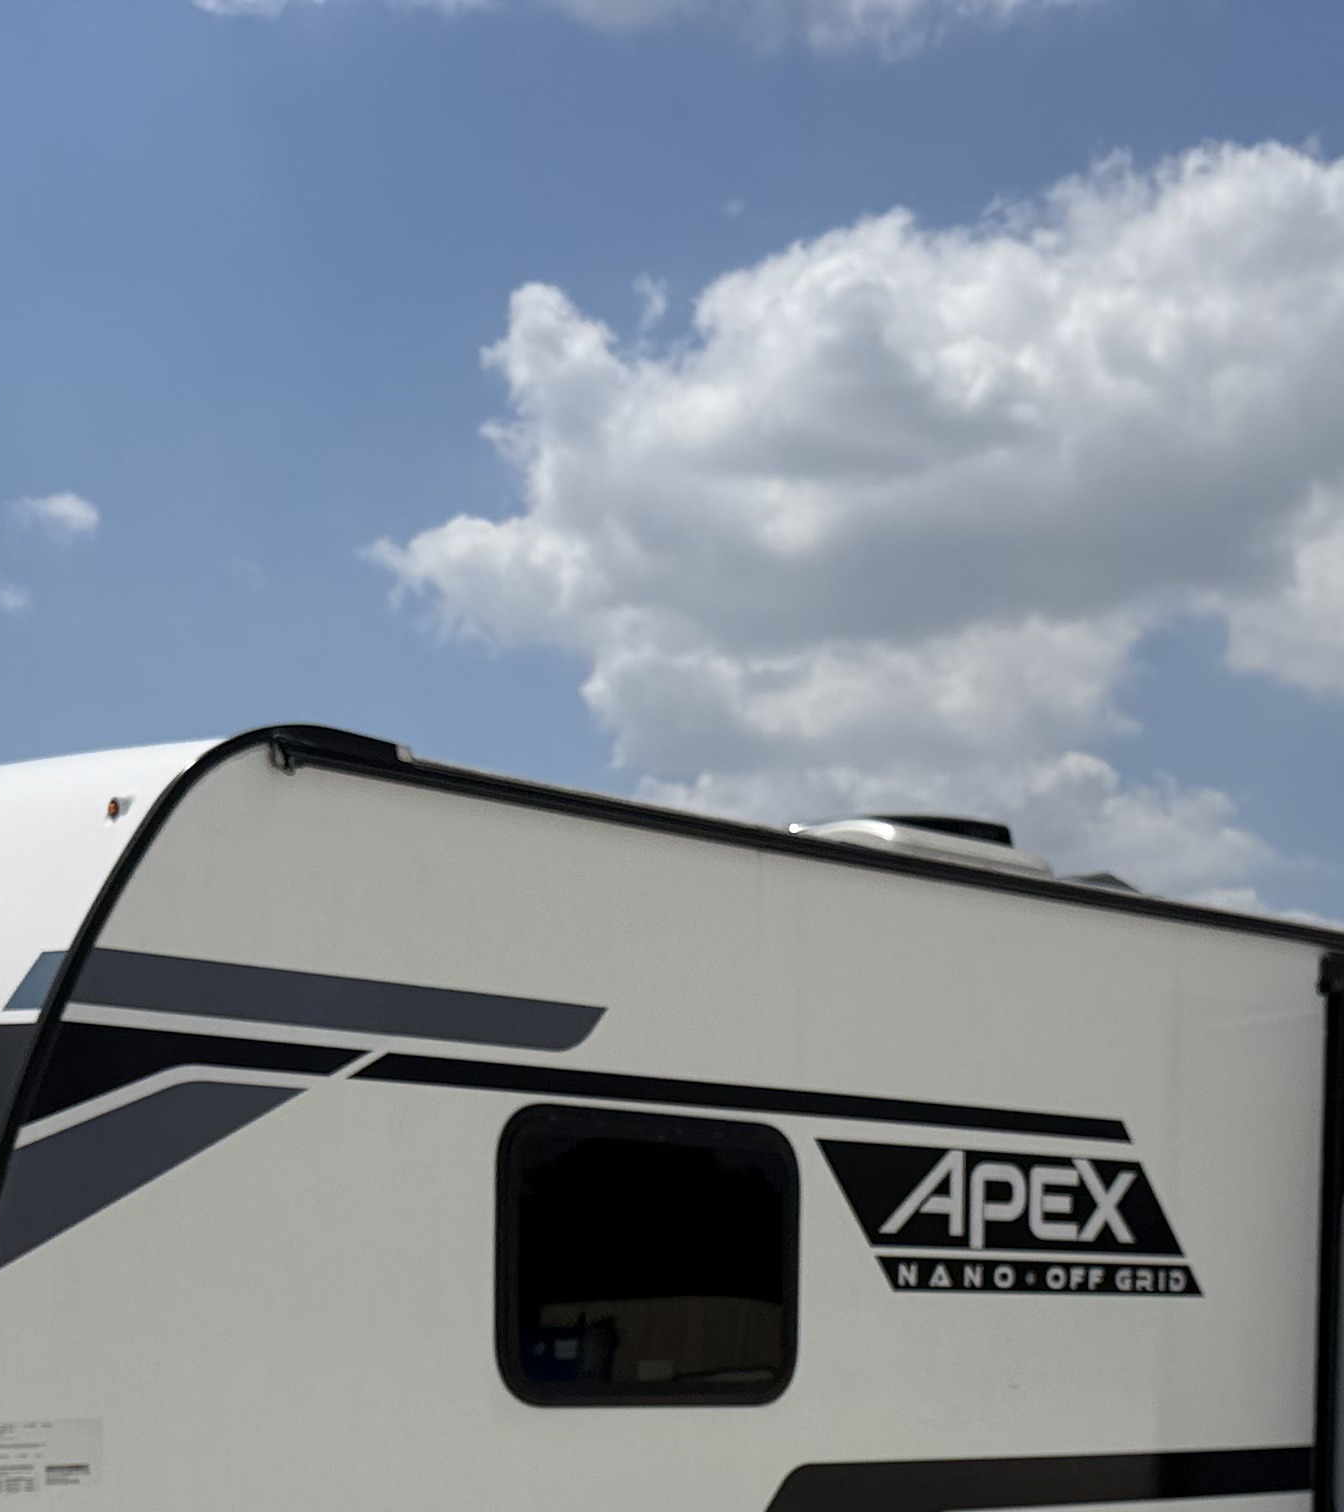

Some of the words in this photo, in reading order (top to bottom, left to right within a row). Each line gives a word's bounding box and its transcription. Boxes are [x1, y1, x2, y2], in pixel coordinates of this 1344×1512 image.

[878, 1149, 1137, 1249] APEX
[897, 1261, 1017, 1289] NANO
[1045, 1265, 1105, 1291] OFF
[1115, 1266, 1188, 1292] GRID
